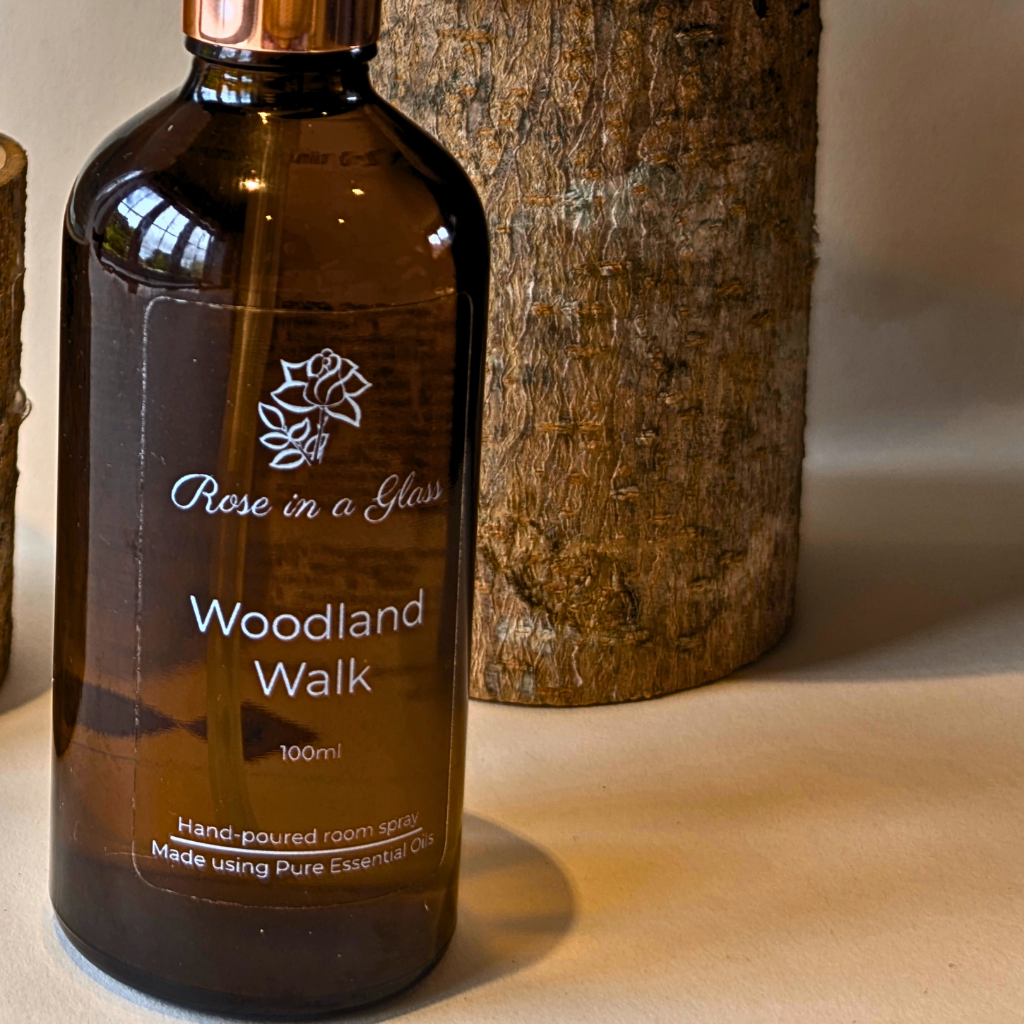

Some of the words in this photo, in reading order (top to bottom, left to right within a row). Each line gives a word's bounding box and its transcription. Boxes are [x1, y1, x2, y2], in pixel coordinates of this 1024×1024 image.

[170, 473, 272, 517] Rose
[282, 493, 320, 519] in
[331, 497, 357, 518] a
[364, 471, 443, 524] Glass
[189, 587, 424, 641] Woodland
[253, 657, 372, 697] Walk
[279, 743, 342, 762] 100ml
[177, 816, 318, 847] Hand-poured
[323, 825, 374, 843] room
[378, 812, 420, 835] spray
[151, 839, 206, 867] Made
[211, 856, 269, 878] using
[275, 860, 325, 876] Pure
[330, 842, 407, 874] Essential
[410, 832, 435, 854] Oils
